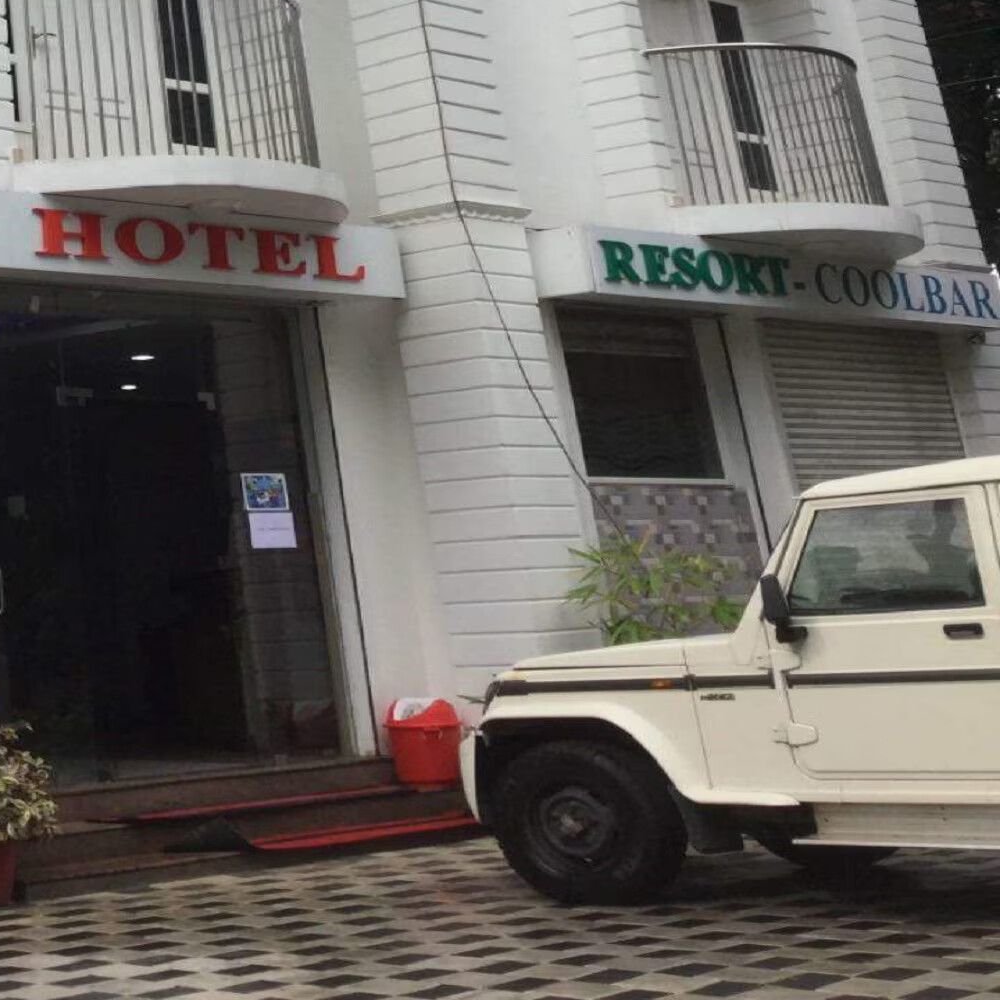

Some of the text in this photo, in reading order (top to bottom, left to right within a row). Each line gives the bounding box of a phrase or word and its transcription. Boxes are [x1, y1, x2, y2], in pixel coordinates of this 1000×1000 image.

[32, 207, 365, 282] HOTEL
[598, 240, 790, 297] RESORT
[814, 263, 998, 319] COOLBAR
